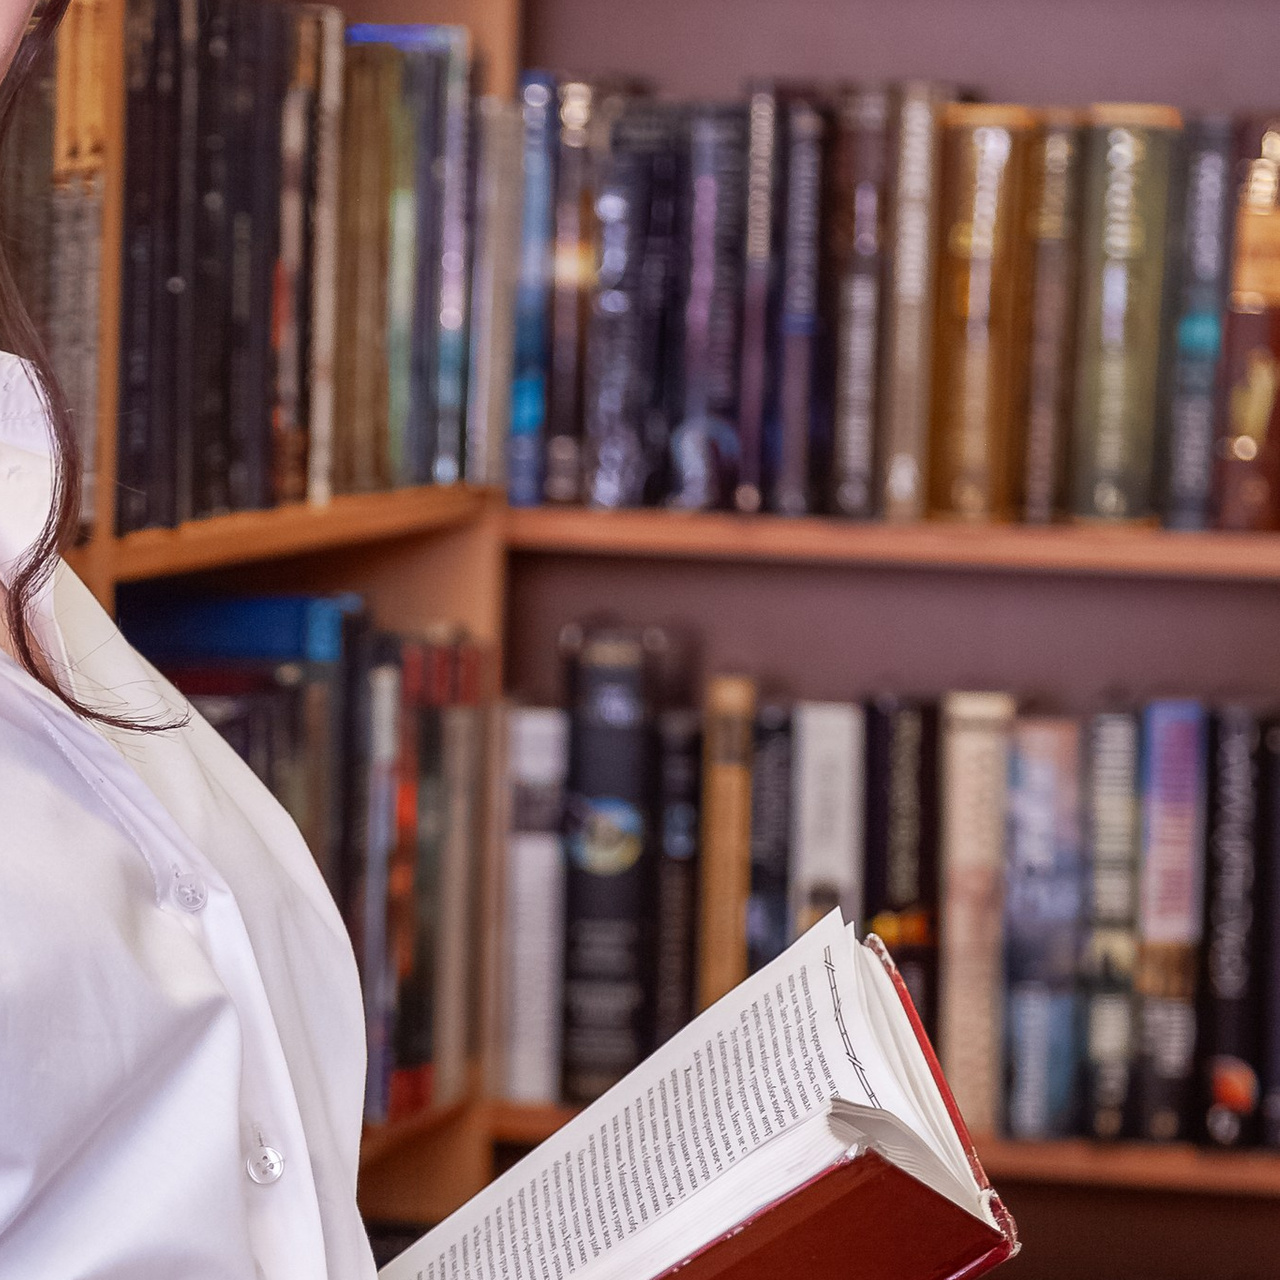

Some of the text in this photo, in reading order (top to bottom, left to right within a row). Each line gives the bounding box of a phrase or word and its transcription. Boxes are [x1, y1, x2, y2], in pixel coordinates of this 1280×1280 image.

[803, 1057, 817, 1085] Эроса,
[812, 1083, 824, 1104] стол
[817, 1050, 831, 1081] земляне
[730, 1111, 742, 1136] Никто
[710, 1146, 720, 1164] свое
[719, 1131, 730, 1152] дома
[654, 1152, 668, 1194] щиколоток,
[671, 1165, 684, 1196] черным,
[687, 1167, 697, 1190] низки
[645, 1174, 660, 1214] короткими
[638, 1202, 647, 1222] выше
[561, 1234, 574, 1270] Красивые
